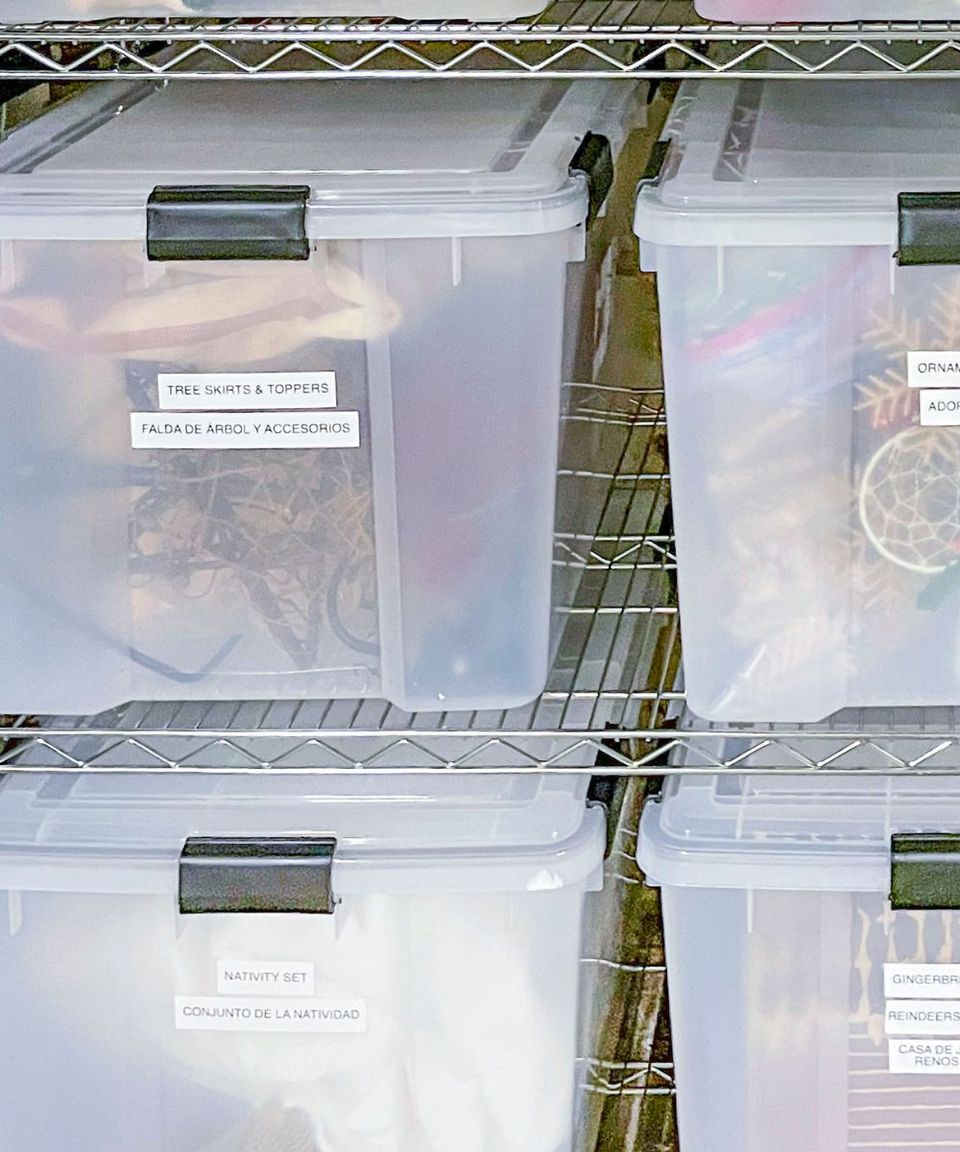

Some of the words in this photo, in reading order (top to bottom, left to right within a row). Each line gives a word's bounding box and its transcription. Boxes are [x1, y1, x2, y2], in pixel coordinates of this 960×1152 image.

[168, 385, 200, 395] TREE
[205, 384, 251, 395] SKIRTS
[256, 384, 263, 395] &
[268, 383, 329, 395] TOPPERS
[142, 424, 181, 434] FALDA
[186, 424, 201, 434] DE
[206, 422, 250, 434] ÁRBOL
[254, 424, 261, 434] Y
[265, 423, 350, 434] ACCESORIOS
[225, 971, 280, 982] NATIVITY
[284, 972, 307, 982] SET
[183, 1006, 251, 1018] CONJUNTO
[254, 1009, 271, 1018] DE
[276, 1009, 291, 1019] LA
[294, 1009, 360, 1019] NATIVIDAD
[888, 1011, 960, 1021] REINDEERS
[899, 1044, 932, 1054] CASA
[936, 1045, 952, 1054] DE
[915, 1057, 959, 1066] RENOS
